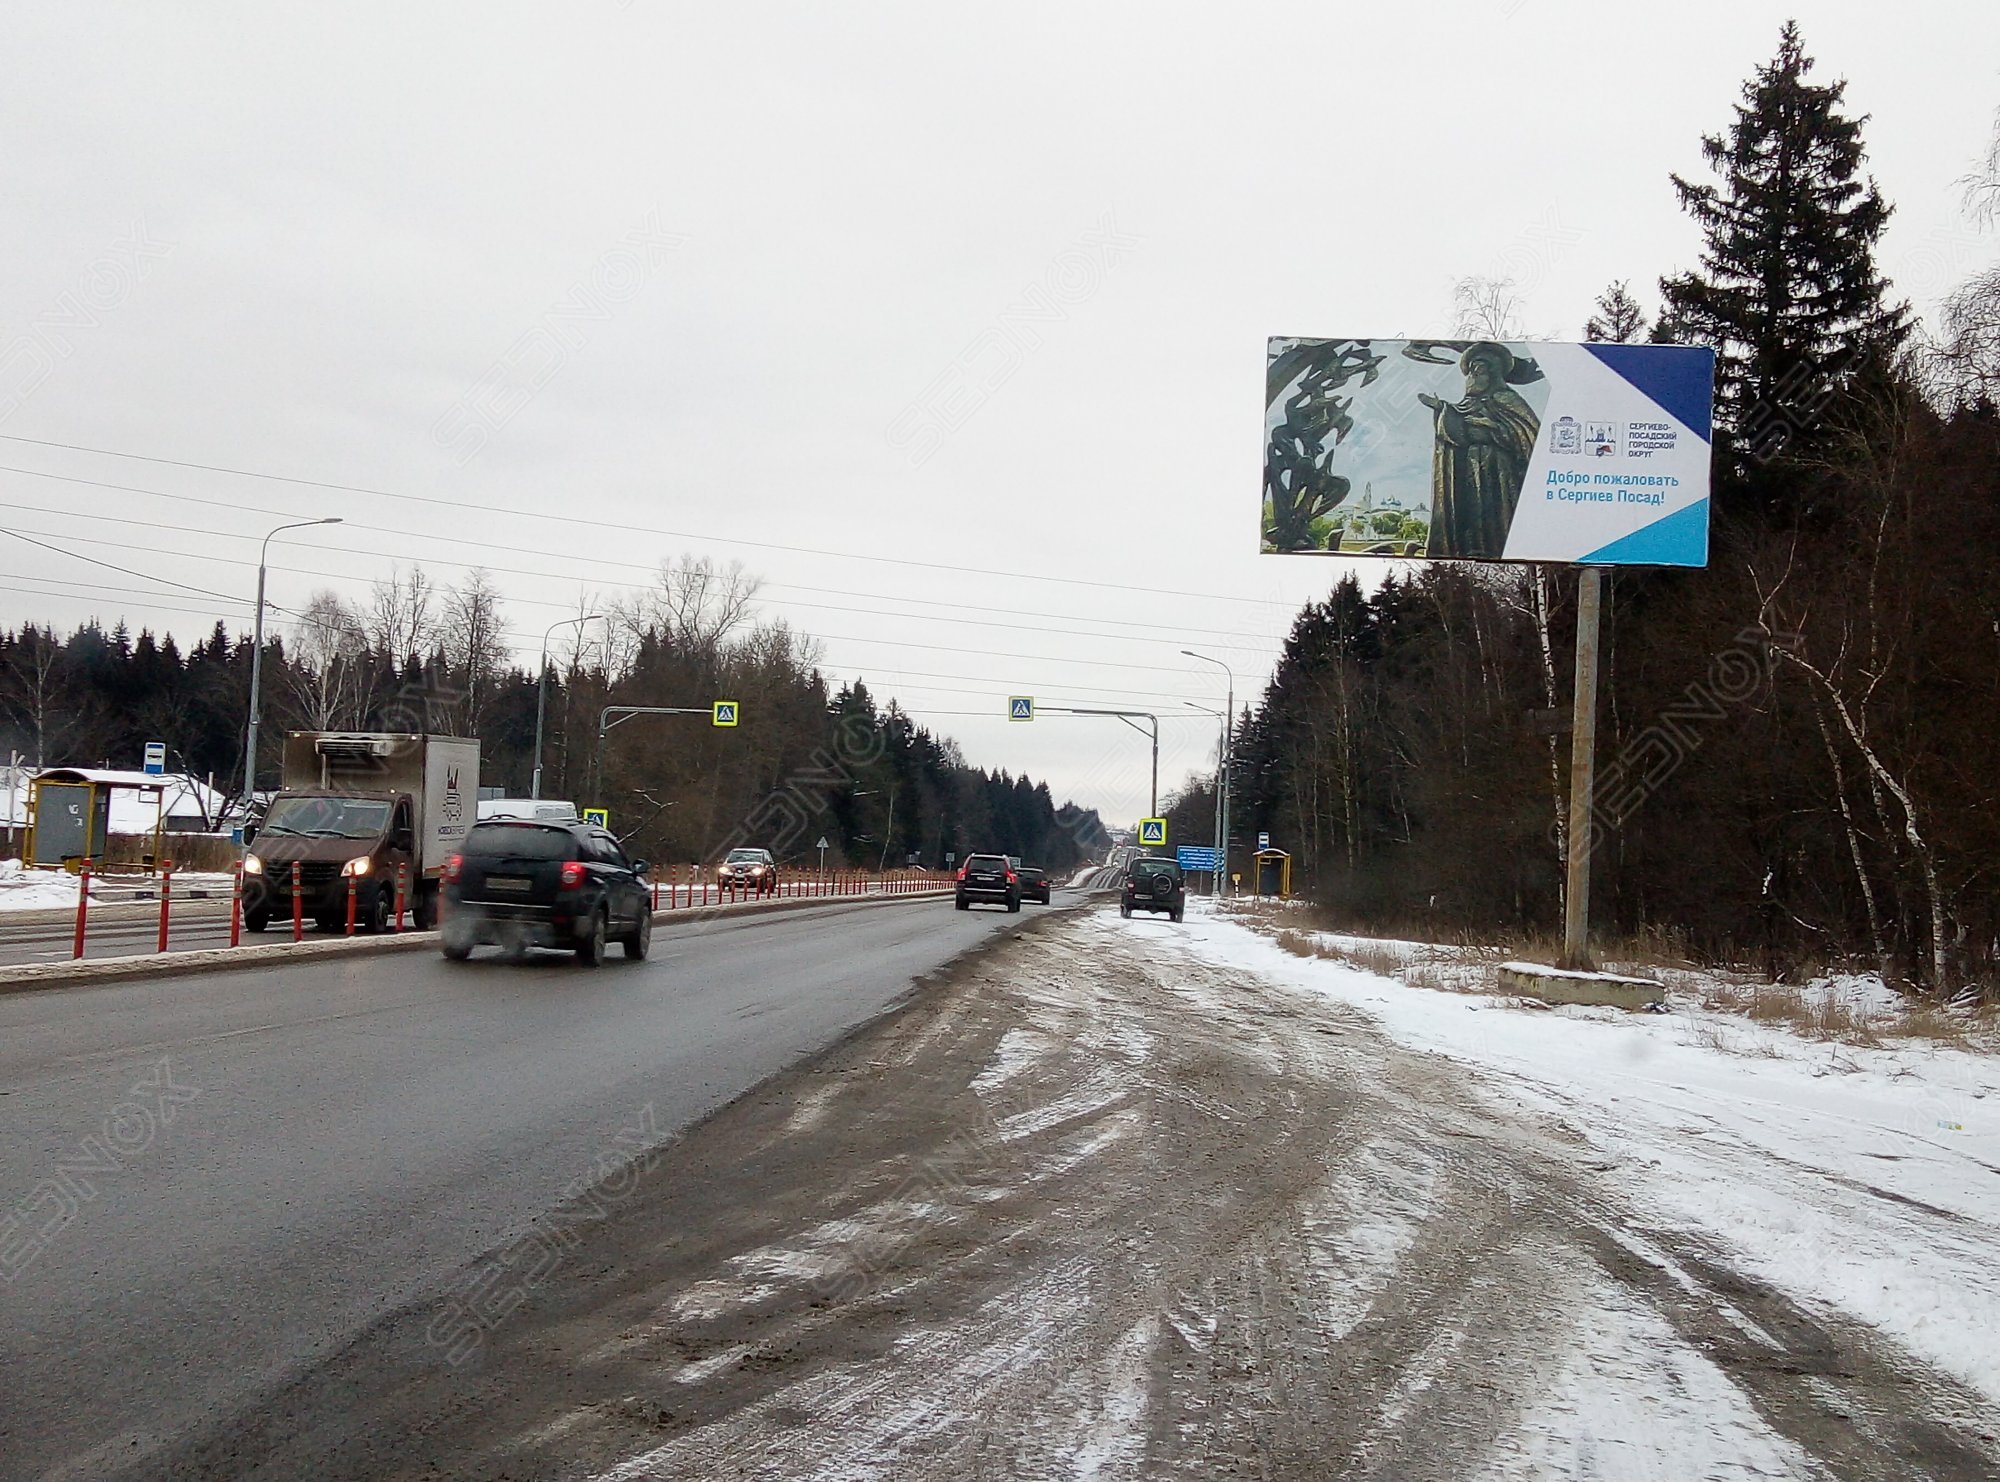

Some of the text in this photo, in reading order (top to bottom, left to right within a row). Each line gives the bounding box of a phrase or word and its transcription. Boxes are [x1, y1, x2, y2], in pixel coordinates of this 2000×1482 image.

[1629, 422, 1671, 431] СЕРГИЕВО-
[1629, 431, 1677, 440] ПОСАДСКИЙ
[1628, 440, 1675, 450] ГОРОДСКОЙ
[1628, 450, 1654, 458] ОКРУГ
[1546, 470, 1679, 487] Добро пожаловать
[1546, 488, 1665, 505] в Сергиев Посад!
